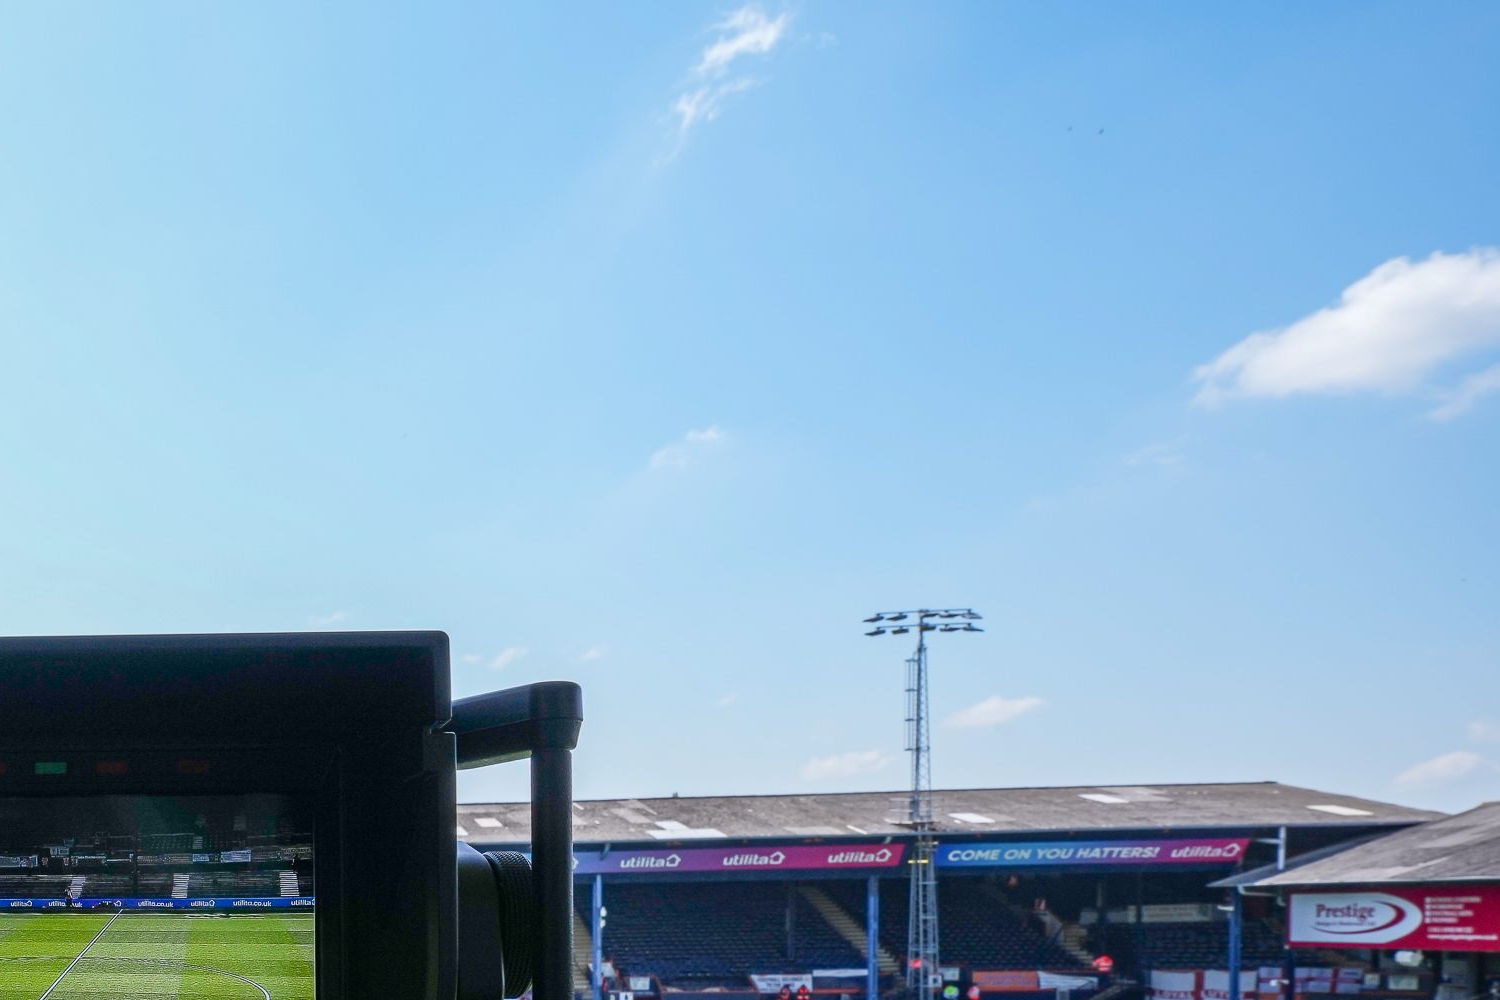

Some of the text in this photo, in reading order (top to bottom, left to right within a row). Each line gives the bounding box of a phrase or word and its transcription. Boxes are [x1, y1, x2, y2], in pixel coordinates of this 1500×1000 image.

[948, 846, 1160, 861] COME ON YOU HATTERS!
[1171, 845, 1221, 858] utilita
[620, 857, 665, 869] utilita
[722, 855, 769, 866] utilita
[828, 852, 875, 864] utilita
[1315, 904, 1376, 922] Prestige
